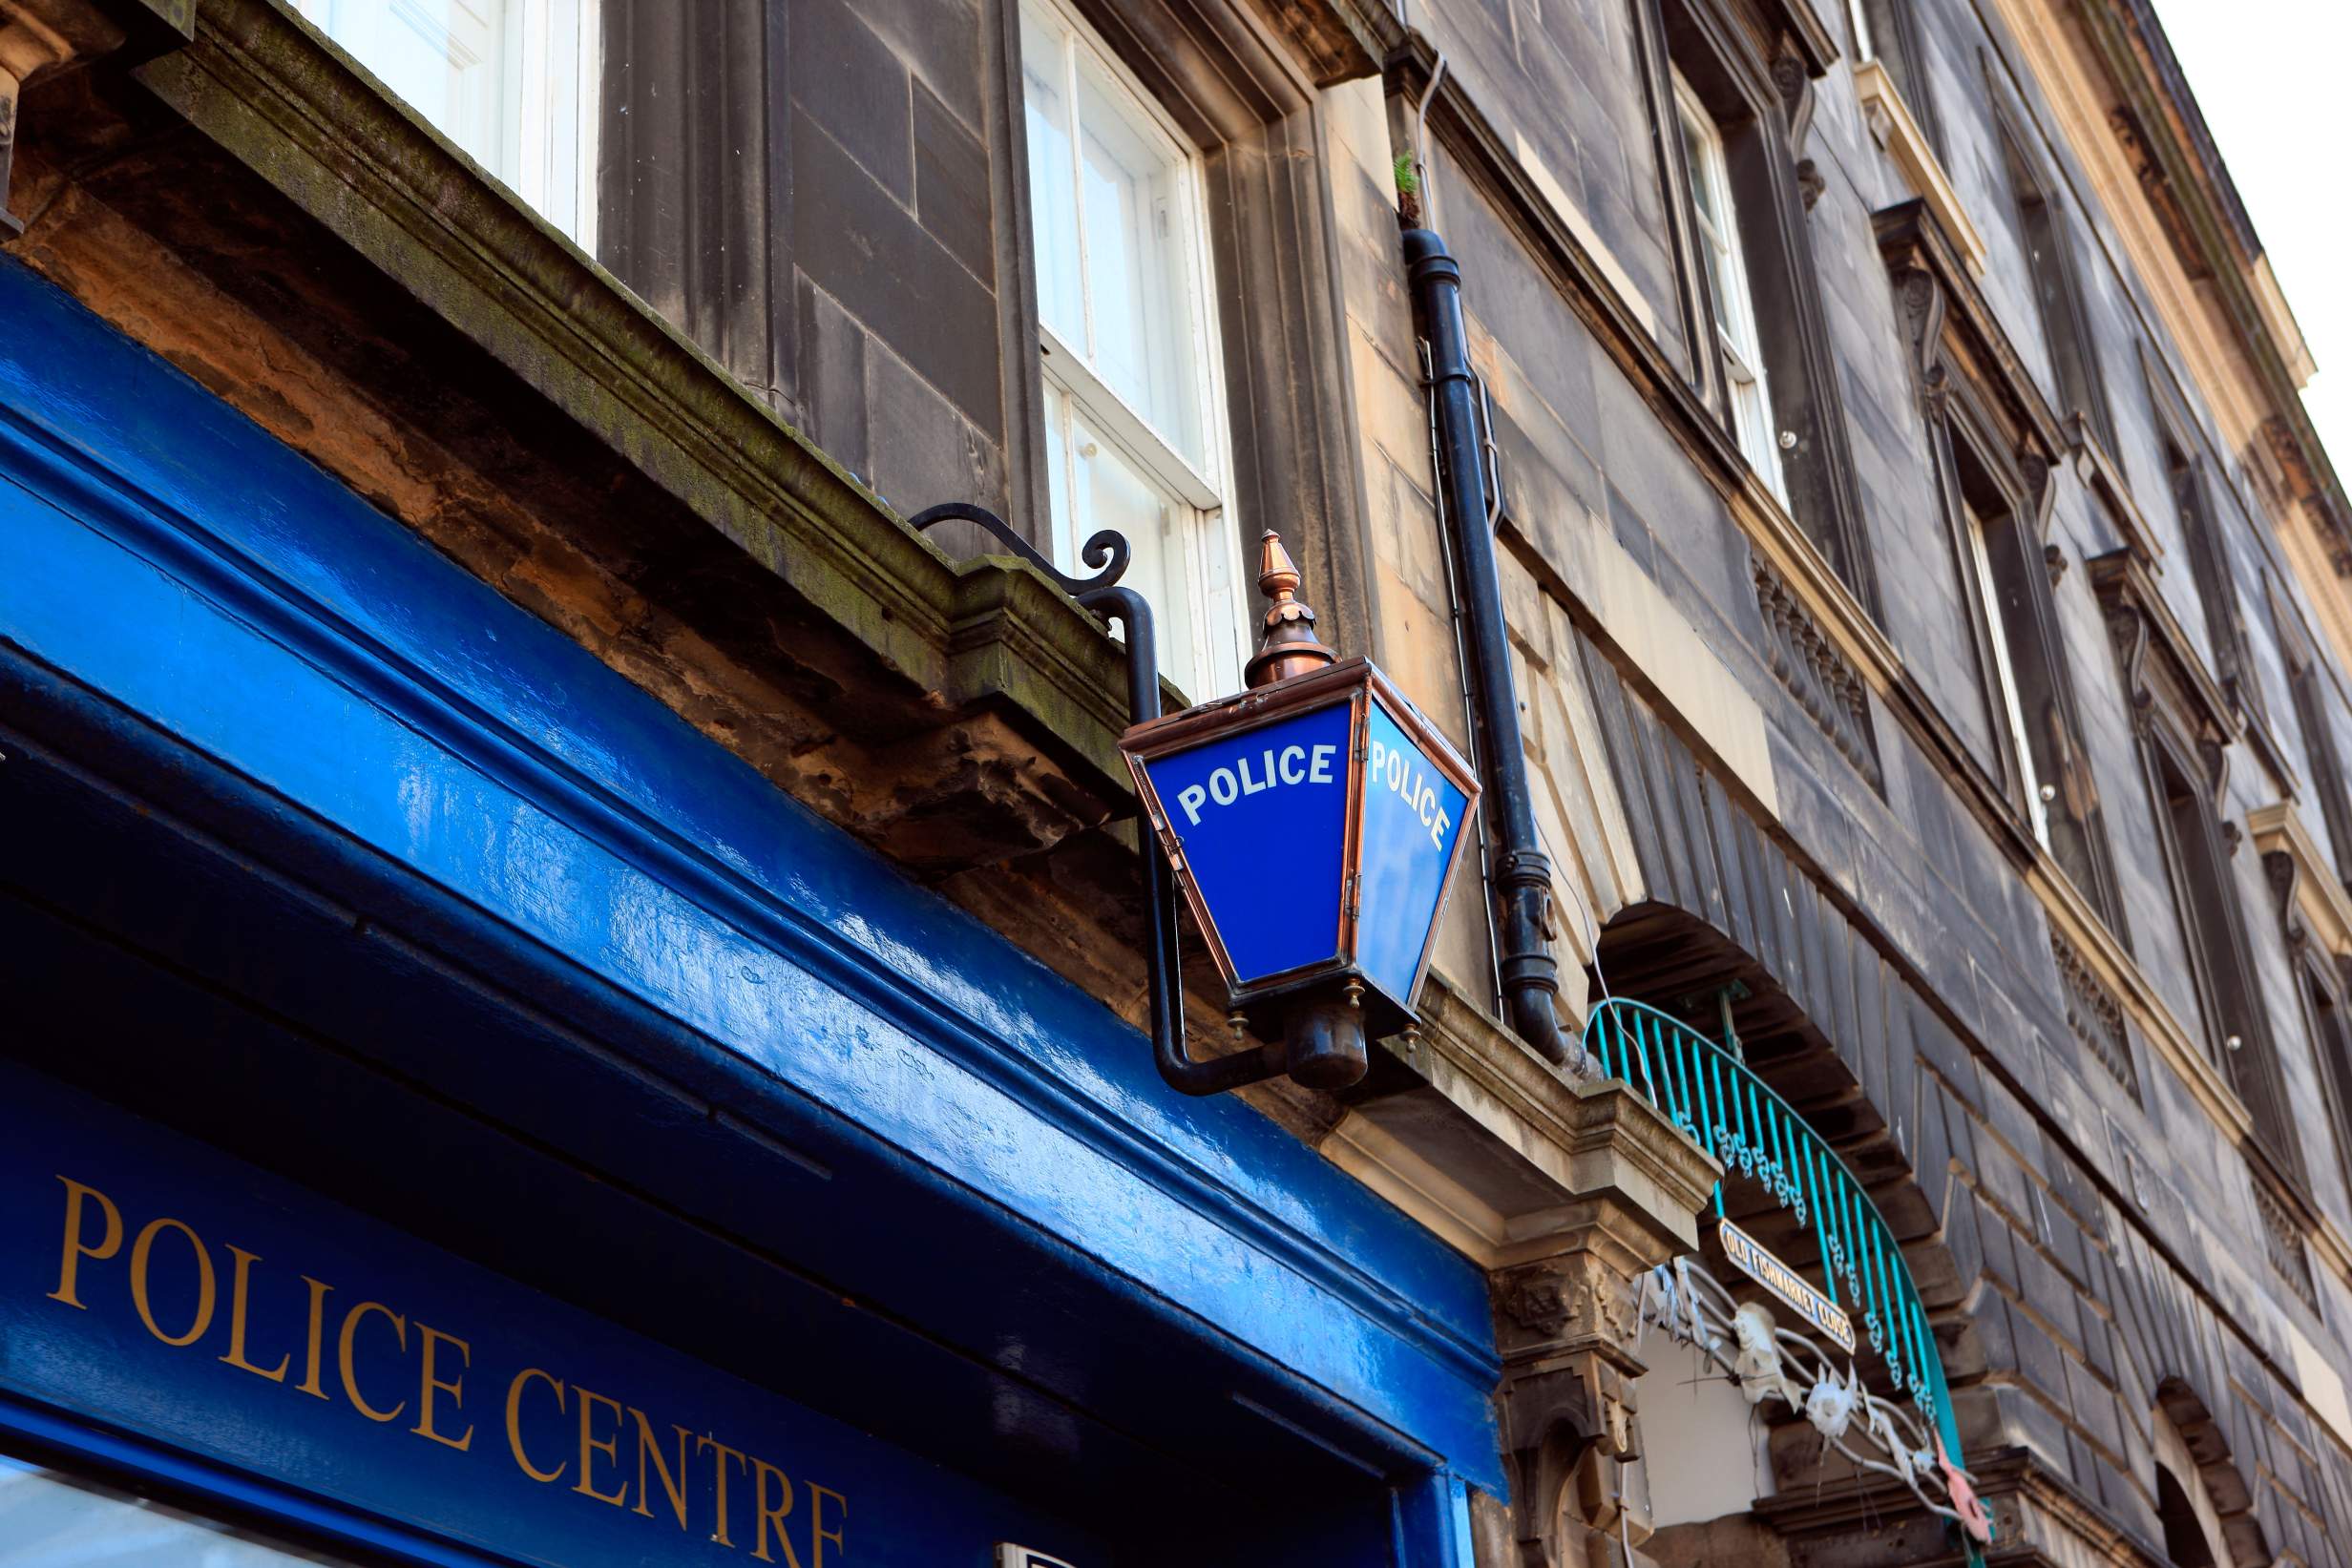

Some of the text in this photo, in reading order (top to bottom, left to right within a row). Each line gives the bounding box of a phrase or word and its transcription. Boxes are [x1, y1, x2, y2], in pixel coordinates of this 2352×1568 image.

[1177, 744, 1336, 826] POLICE
[1372, 740, 1451, 852] POLICE
[1726, 1230, 1852, 1343] OLD FISHMARKET CLOSE
[46, 1174, 849, 1568] POLICE CENTRE
